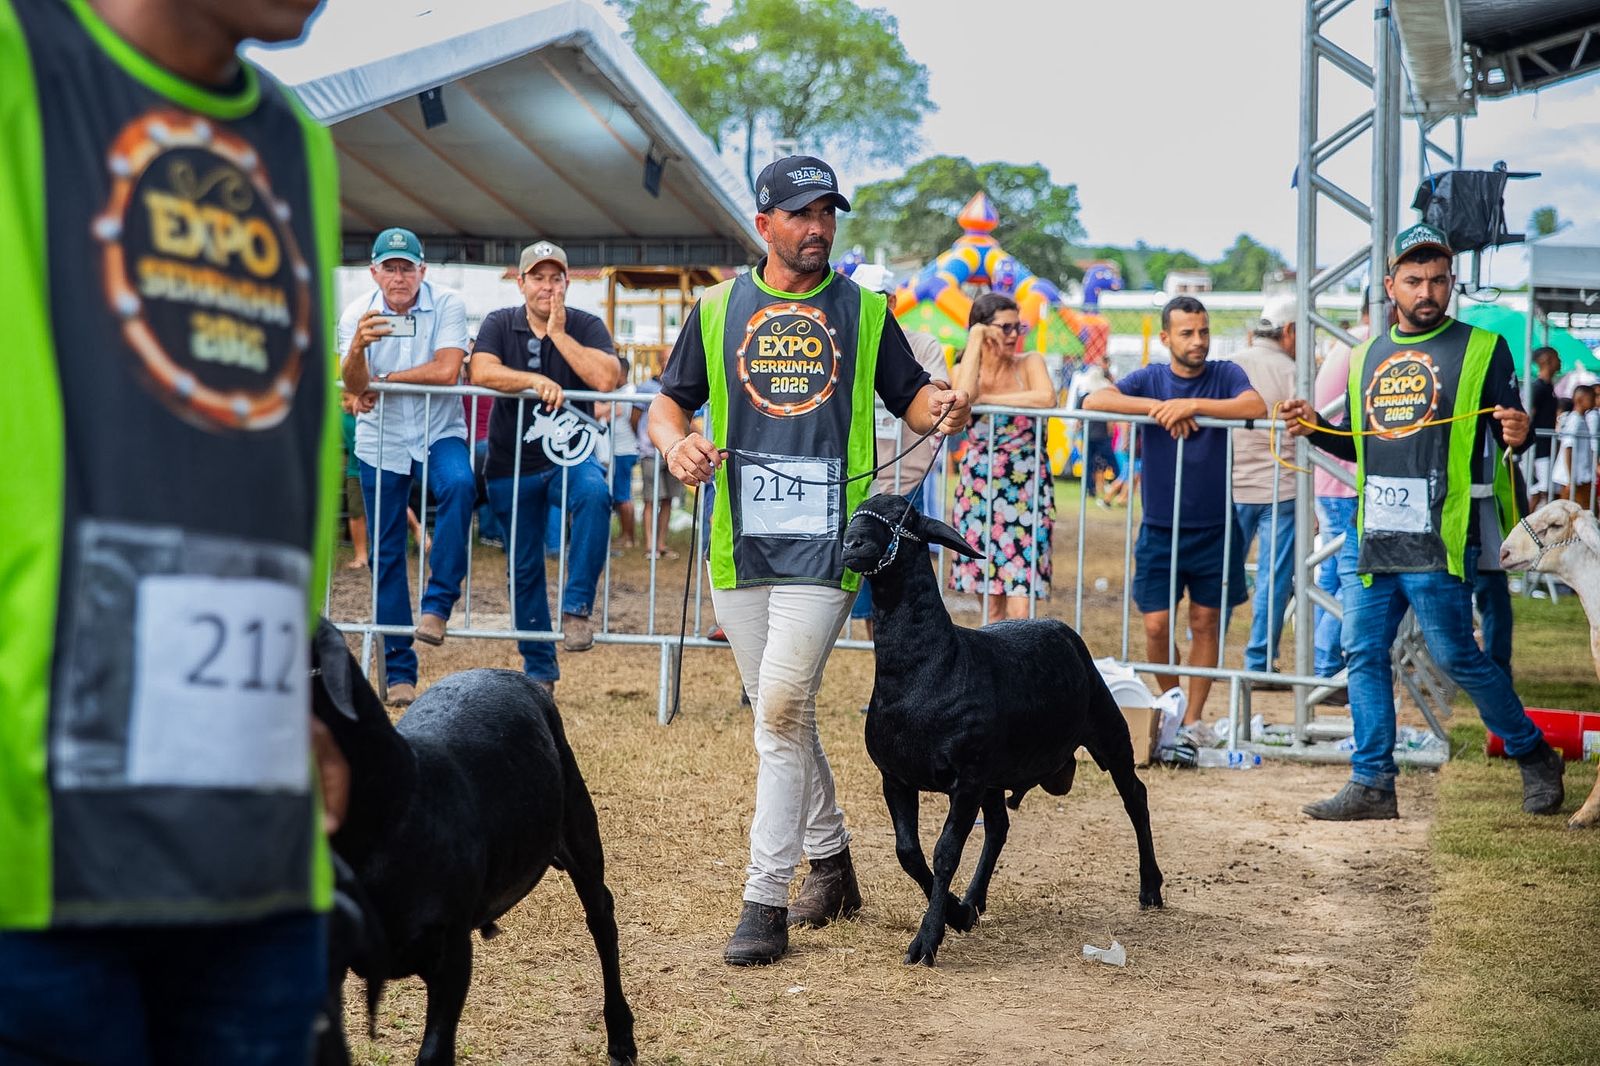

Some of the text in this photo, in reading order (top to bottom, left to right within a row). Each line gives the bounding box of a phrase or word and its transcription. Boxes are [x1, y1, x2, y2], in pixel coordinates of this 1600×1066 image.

[144, 190, 281, 278] EXPO
[757, 335, 823, 358] EXPO
[750, 359, 825, 375] SERRINHA
[770, 376, 809, 394] 2026
[1379, 374, 1427, 395] EXPO
[1373, 393, 1427, 408] SERRINHA
[1383, 406, 1415, 422] 2026
[752, 475, 806, 502] 214
[1374, 485, 1411, 508] 202
[183, 612, 298, 694] 212
